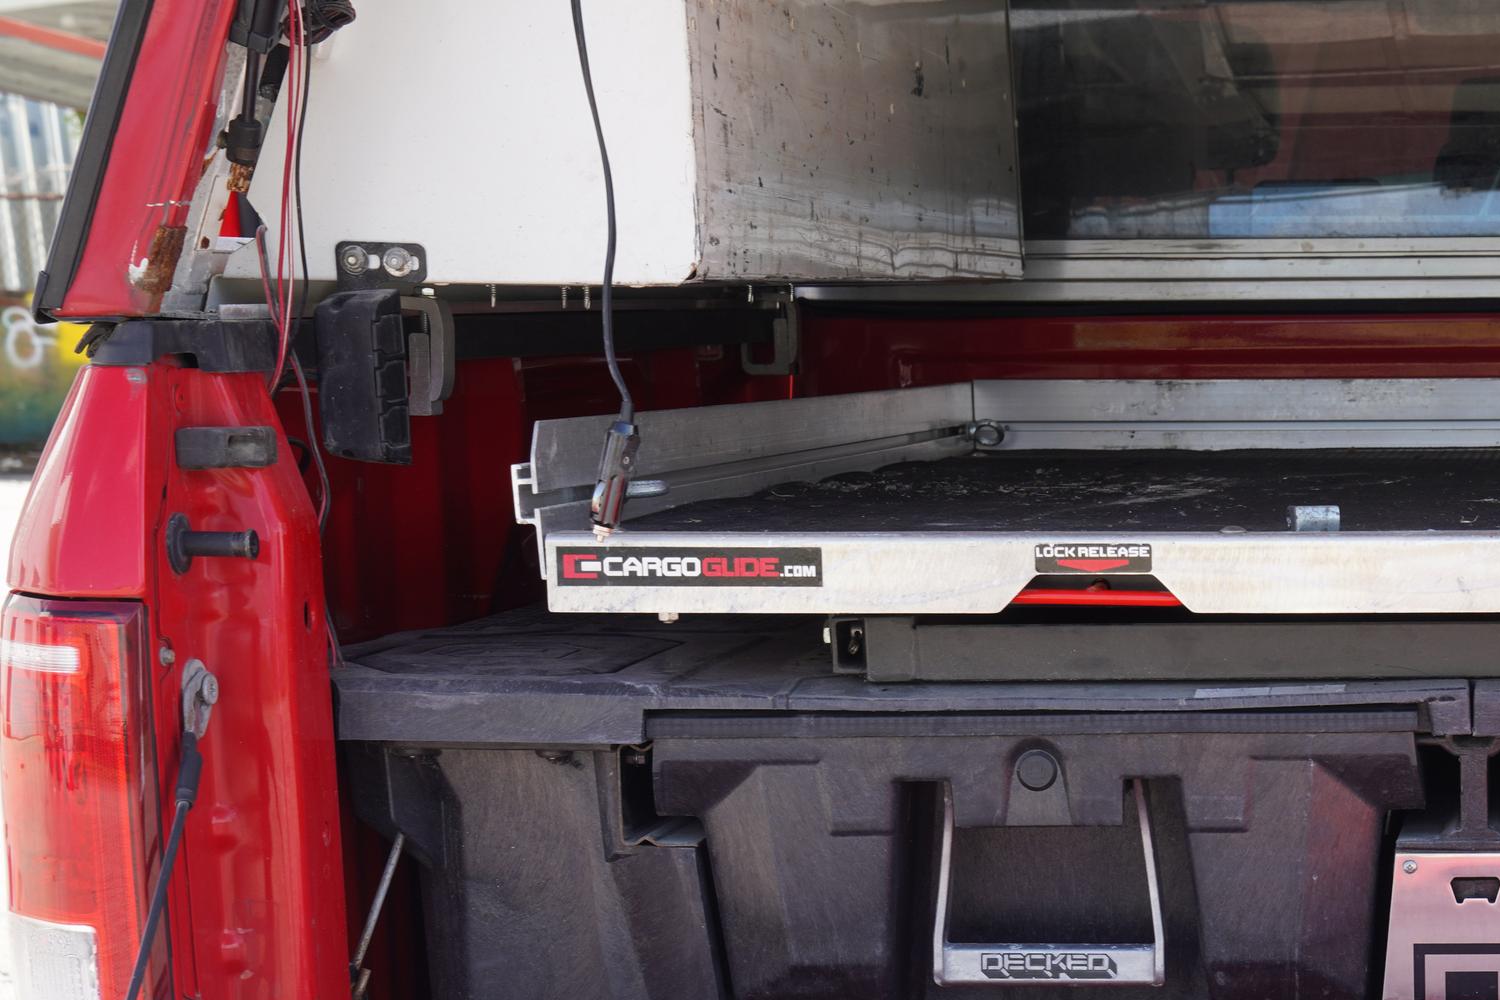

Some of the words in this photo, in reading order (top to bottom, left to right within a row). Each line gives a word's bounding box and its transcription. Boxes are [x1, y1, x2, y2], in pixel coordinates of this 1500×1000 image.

[1035, 546, 1077, 557] LOCK
[1078, 546, 1150, 557] RELEASE
[981, 952, 1115, 977] DECKED
